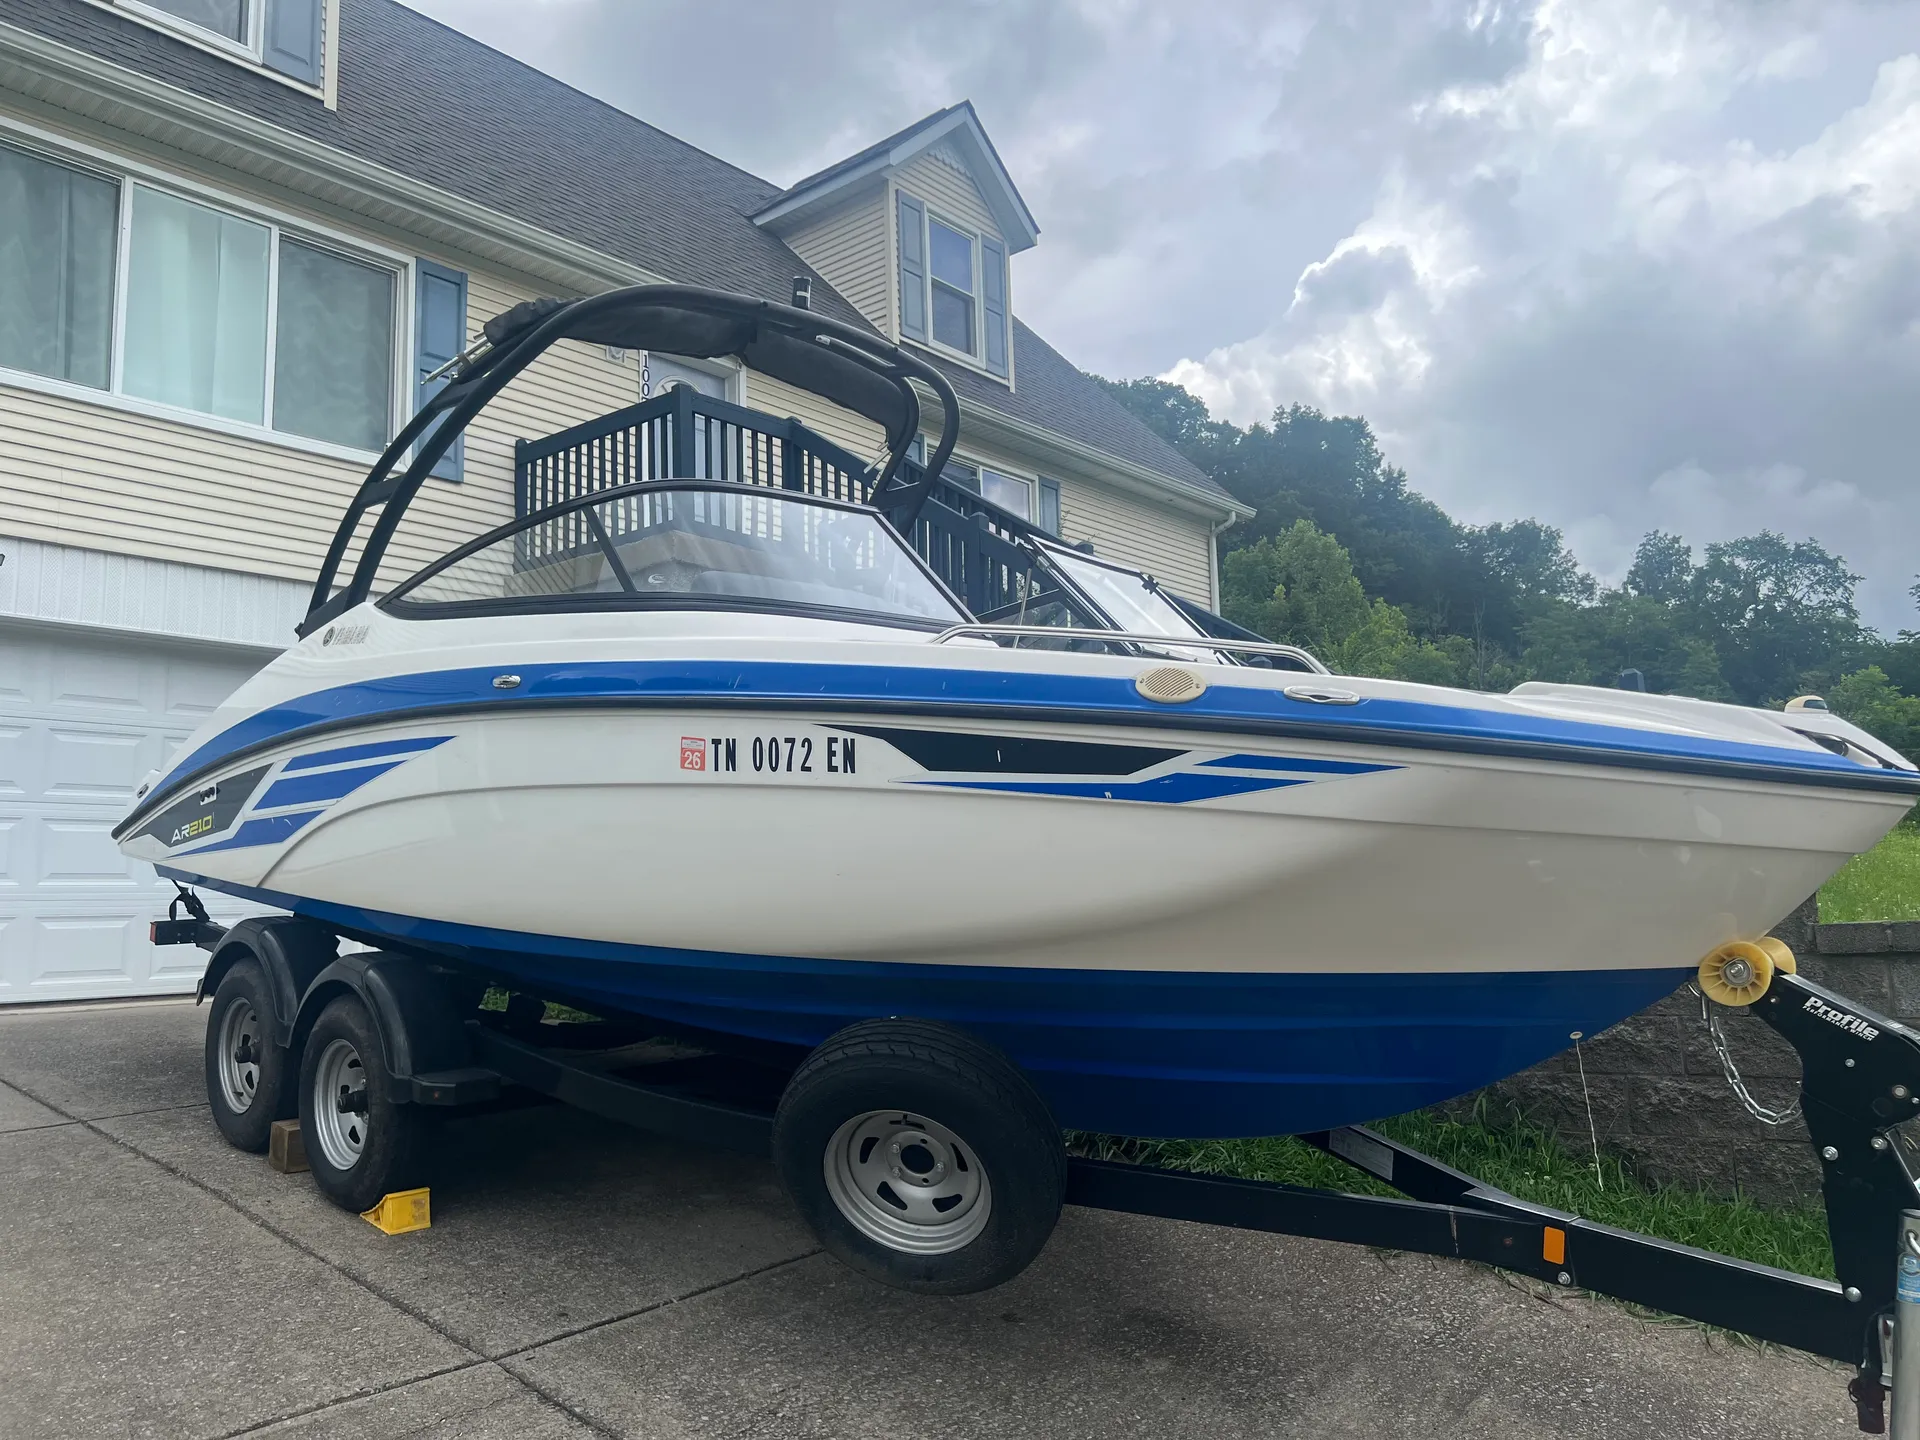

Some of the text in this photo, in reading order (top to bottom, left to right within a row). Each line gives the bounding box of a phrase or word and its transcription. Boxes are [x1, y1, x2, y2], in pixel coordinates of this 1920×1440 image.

[684, 751, 701, 769] 26
[711, 736, 856, 774] TN 0072 EN
[171, 815, 212, 844] AR210
[1802, 1005, 1849, 1030] PERFORMANCE
[1850, 1027, 1873, 1041] WINCH
[1804, 996, 1880, 1039] Profile
